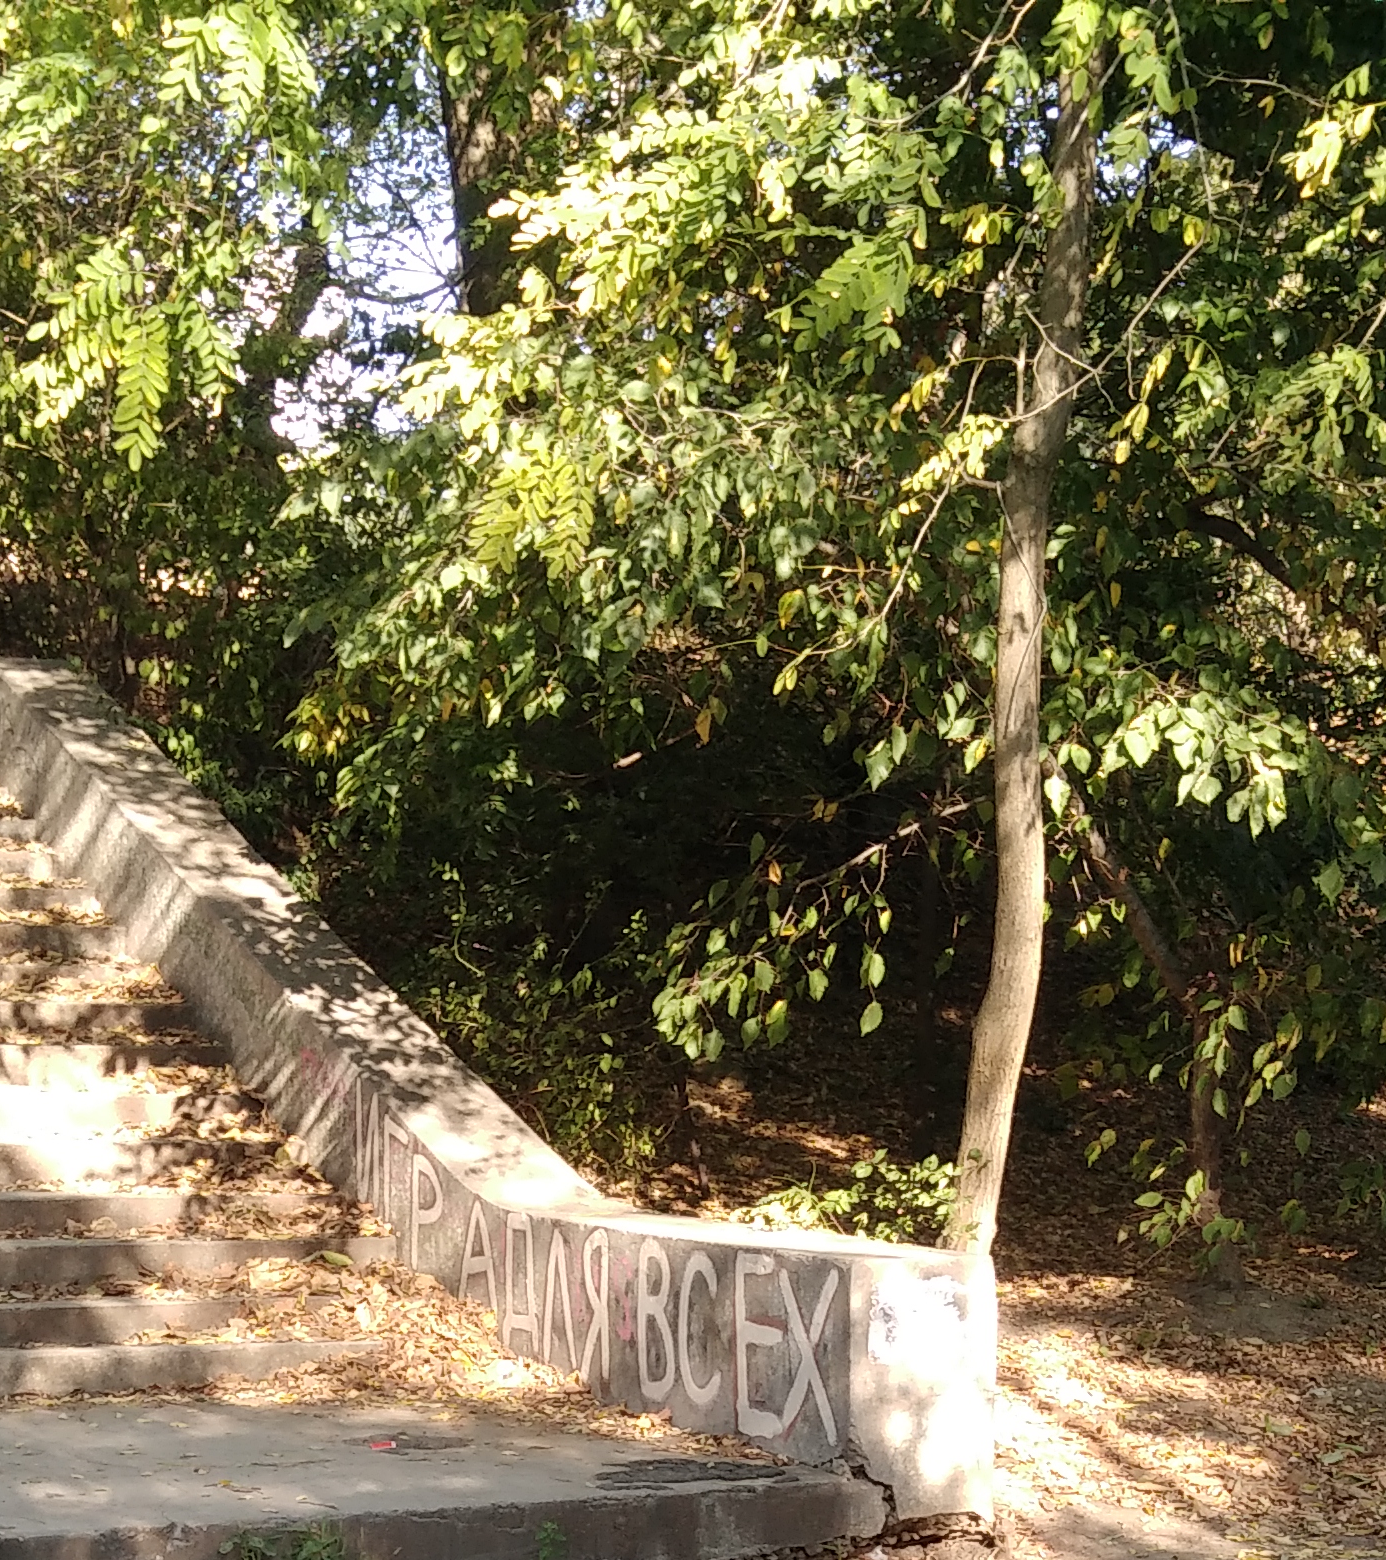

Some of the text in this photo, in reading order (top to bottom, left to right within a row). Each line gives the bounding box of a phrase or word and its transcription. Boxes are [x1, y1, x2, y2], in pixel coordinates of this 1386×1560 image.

[356, 1077, 838, 1447] ИГРА ДЛЯ ВСЕХ
